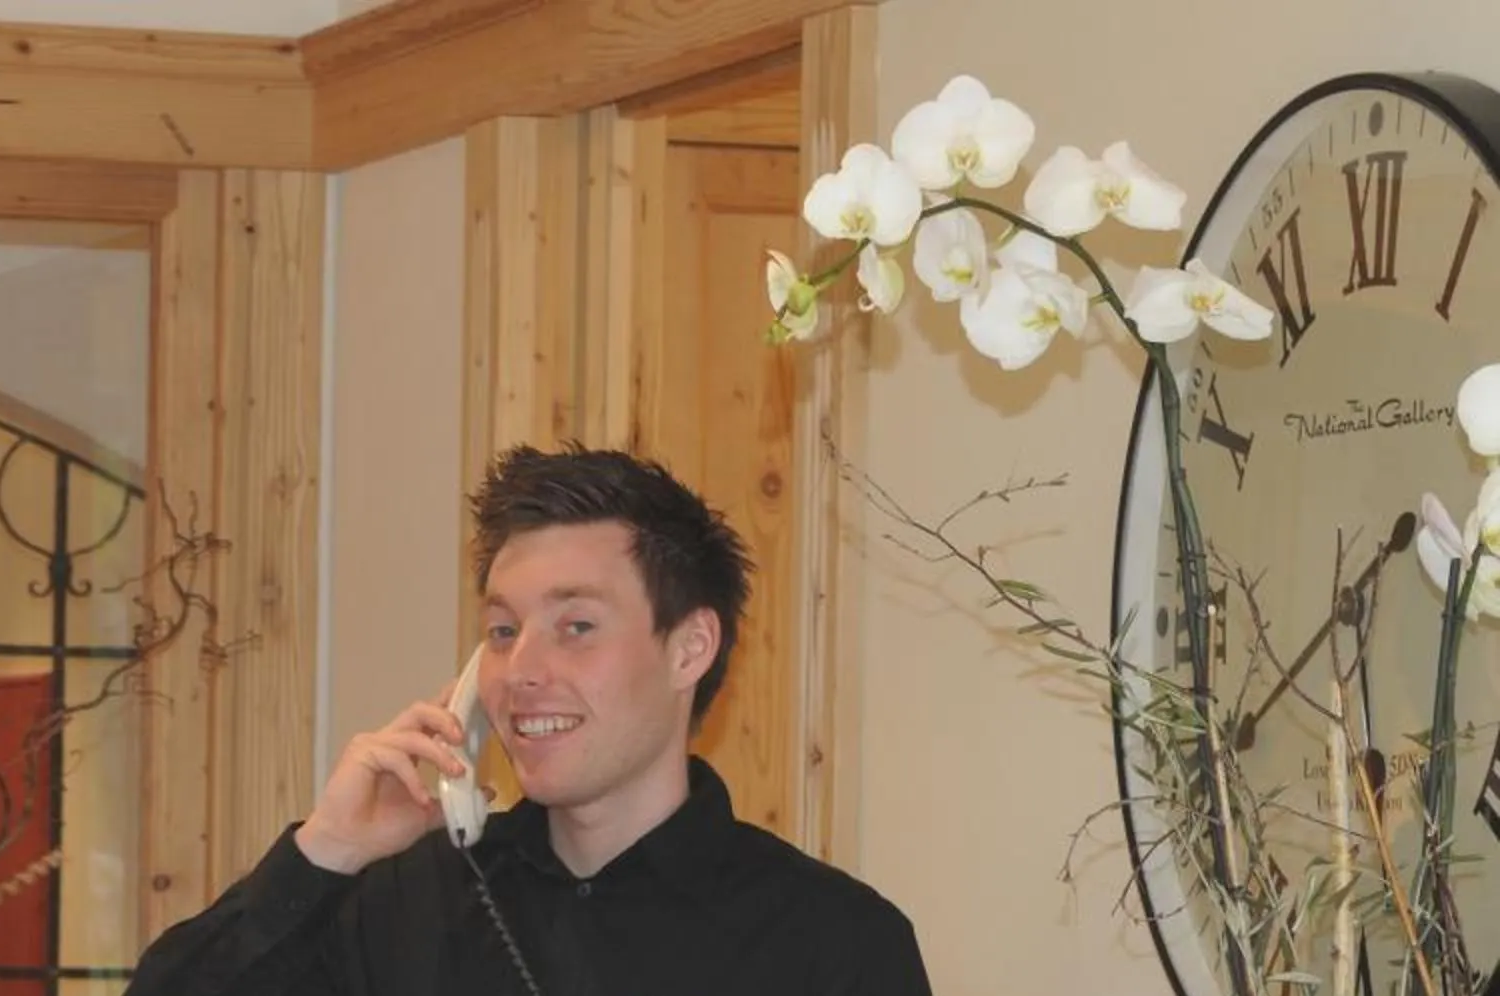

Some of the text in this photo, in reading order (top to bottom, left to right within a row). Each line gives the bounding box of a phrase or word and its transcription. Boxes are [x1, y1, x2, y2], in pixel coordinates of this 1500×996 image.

[1257, 206, 1316, 368] XI
[1342, 151, 1408, 296] XII
[1197, 370, 1255, 492] X
[1283, 398, 1455, 443] National Gallery
